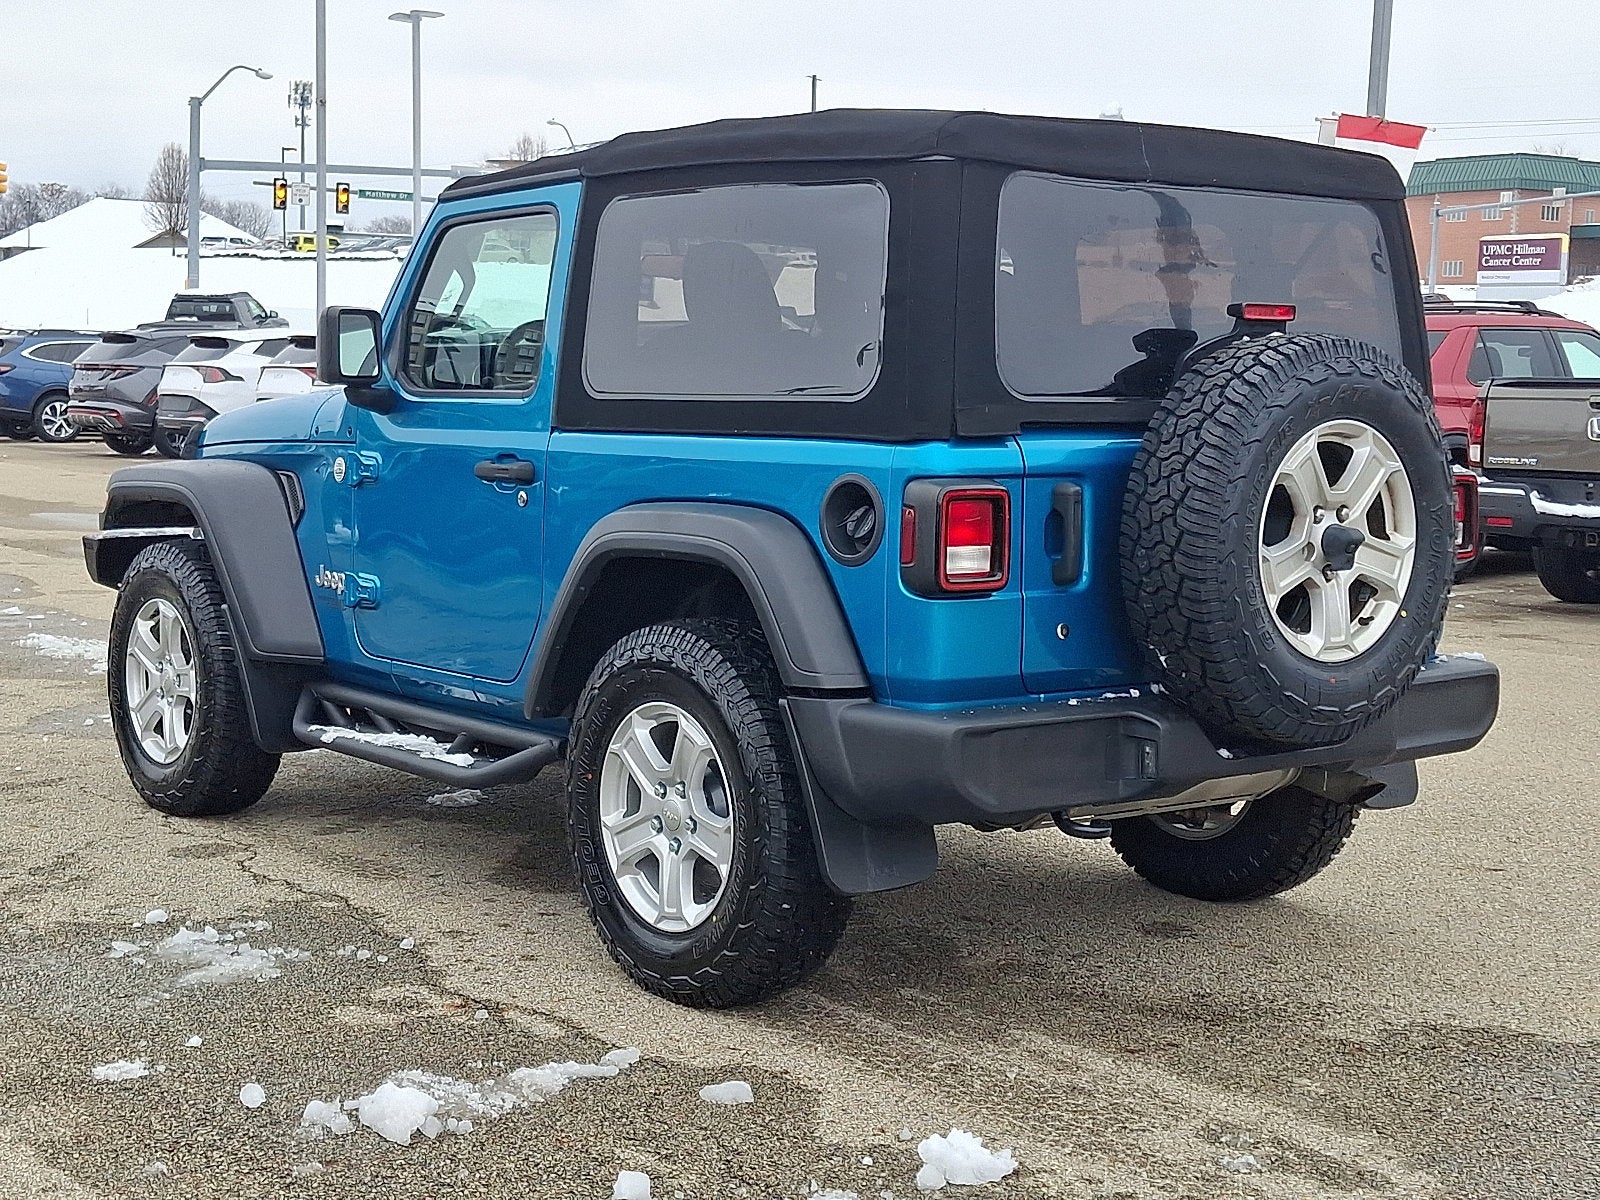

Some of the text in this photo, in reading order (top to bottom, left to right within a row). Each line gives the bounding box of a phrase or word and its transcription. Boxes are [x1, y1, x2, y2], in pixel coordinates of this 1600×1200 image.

[365, 190, 397, 199] Matthew
[1482, 244, 1546, 255] UPMC Hillman
[1481, 255, 1542, 267] Cancer Center
[315, 564, 346, 595] Jeep
